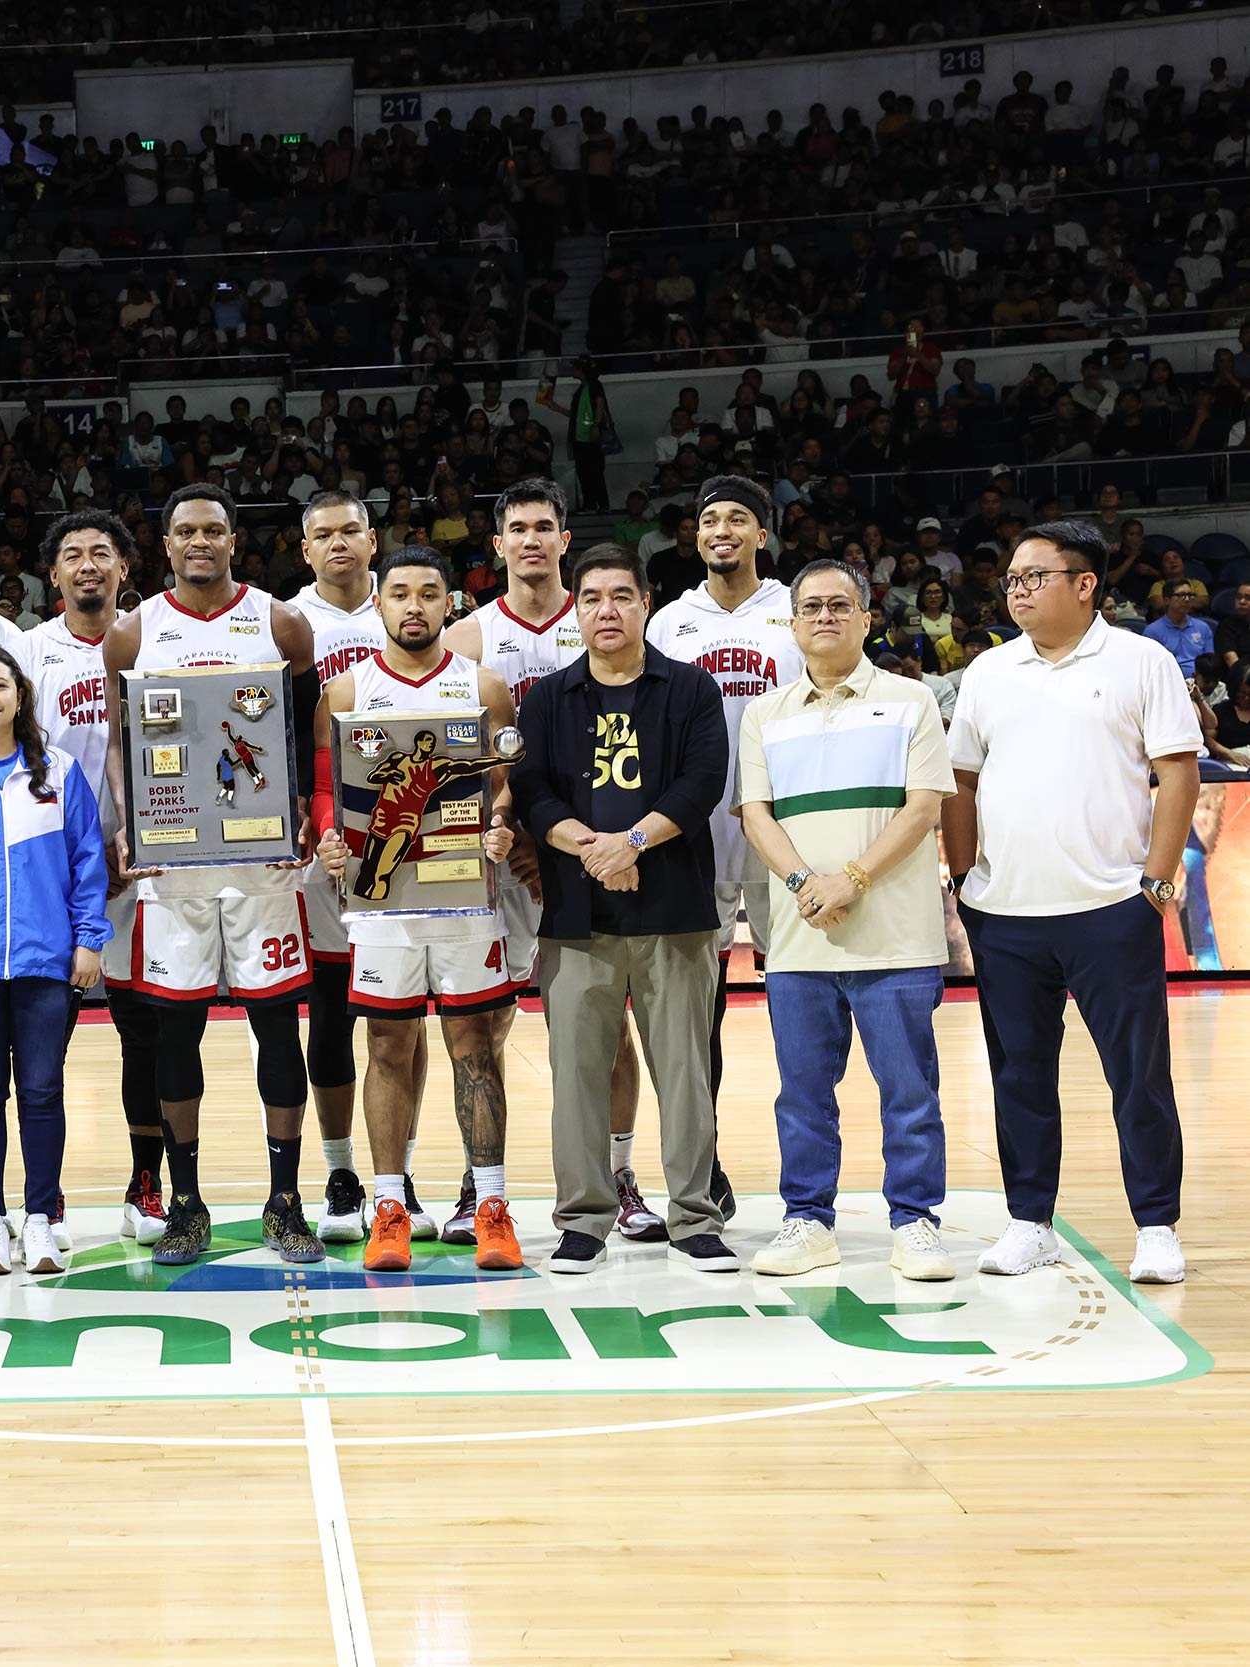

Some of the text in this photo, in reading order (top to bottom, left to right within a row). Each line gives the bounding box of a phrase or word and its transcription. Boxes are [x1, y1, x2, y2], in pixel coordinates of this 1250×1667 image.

[942, 49, 981, 71] 218
[383, 97, 419, 117] 217
[140, 139, 154, 151] XIT
[282, 134, 302, 144] EXIT
[58, 412, 94, 435] 14
[327, 636, 381, 651] BARANGAY
[702, 638, 760, 651] BARANGAY
[177, 650, 238, 664] BARANGAY
[518, 666, 559, 679] BARANGA
[58, 677, 107, 718] GINE
[236, 686, 270, 702] PBA
[69, 710, 95, 727] SAN
[352, 728, 387, 743] PBA
[592, 747, 642, 790] 50
[149, 785, 185, 796] BOBBY
[150, 796, 186, 807] PARKS
[138, 807, 200, 817] BEST IMPORT
[153, 817, 184, 826] AWARD
[261, 933, 301, 971] 32
[484, 938, 502, 974] 4
